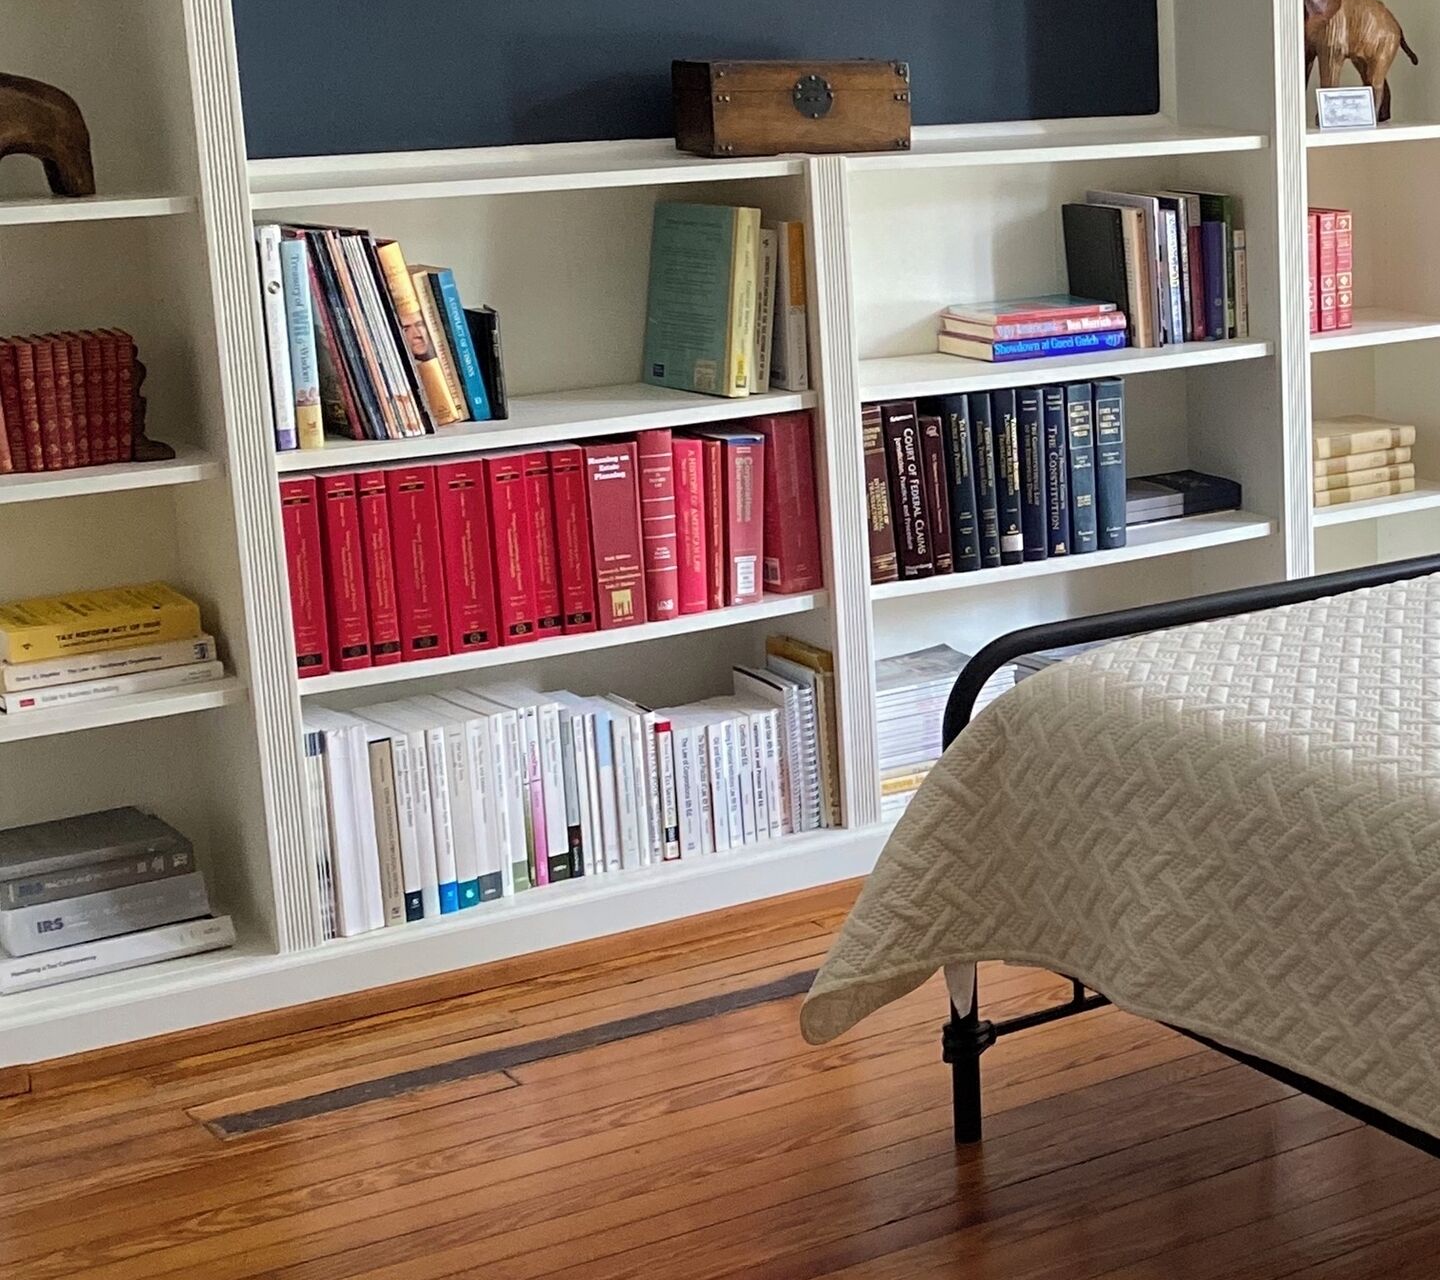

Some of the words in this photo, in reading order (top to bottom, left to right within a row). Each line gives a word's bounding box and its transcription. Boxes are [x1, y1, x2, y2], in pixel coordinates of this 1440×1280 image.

[290, 254, 305, 296] Treasury
[294, 299, 304, 307] of
[292, 309, 309, 337] Wit
[449, 301, 466, 337] CONFLICT
[459, 339, 468, 347] OF
[993, 340, 1041, 355] Showdown
[1041, 340, 1050, 350] at
[299, 346, 312, 383] Wisdom
[903, 428, 916, 461] COURT
[1047, 425, 1058, 449] THE
[594, 471, 626, 481] Planning
[688, 458, 698, 494] HISTORY
[907, 464, 917, 476] OF
[734, 458, 744, 523] Shareholders
[743, 457, 753, 523] Corporations
[899, 476, 908, 502] Practice,
[910, 479, 922, 517] FEDERAL
[1049, 452, 1060, 531] CONSTITUTION
[902, 504, 910, 517] and
[690, 508, 700, 554] AMERICAN
[903, 518, 913, 550] Procedure
[915, 520, 927, 555] CLAIMS
[56, 634, 73, 642] TAX
[75, 628, 110, 640] REFORM
[112, 625, 128, 634] ACT
[739, 724, 747, 747] Conflicts
[764, 716, 772, 730] Land
[682, 748, 690, 759] Law
[714, 757, 722, 768] Gas
[683, 766, 692, 799] Corporations
[715, 769, 723, 780] Law
[36, 917, 65, 934] IRS
